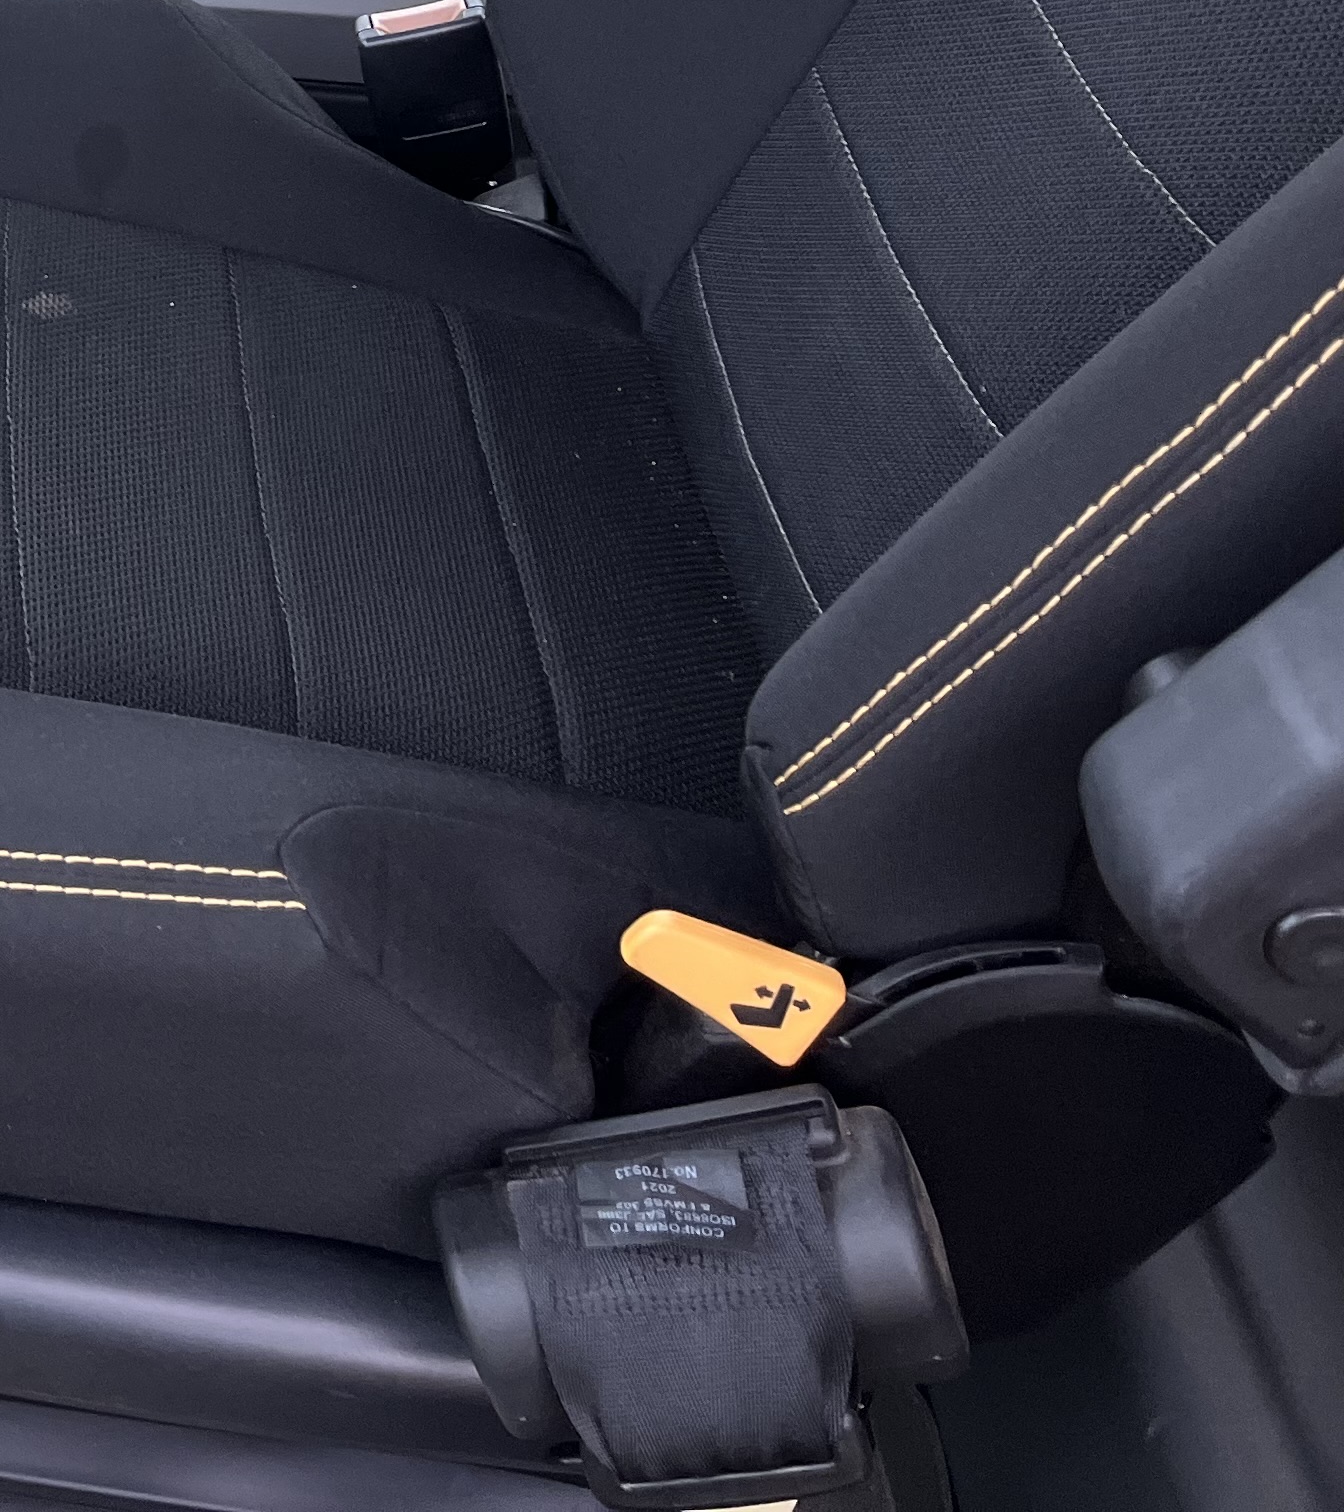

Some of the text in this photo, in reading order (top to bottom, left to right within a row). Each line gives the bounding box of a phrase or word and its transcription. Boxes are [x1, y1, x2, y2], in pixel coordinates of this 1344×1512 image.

[641, 1181, 677, 1195] 2021
[609, 1222, 725, 1238] CONFORMS TO
